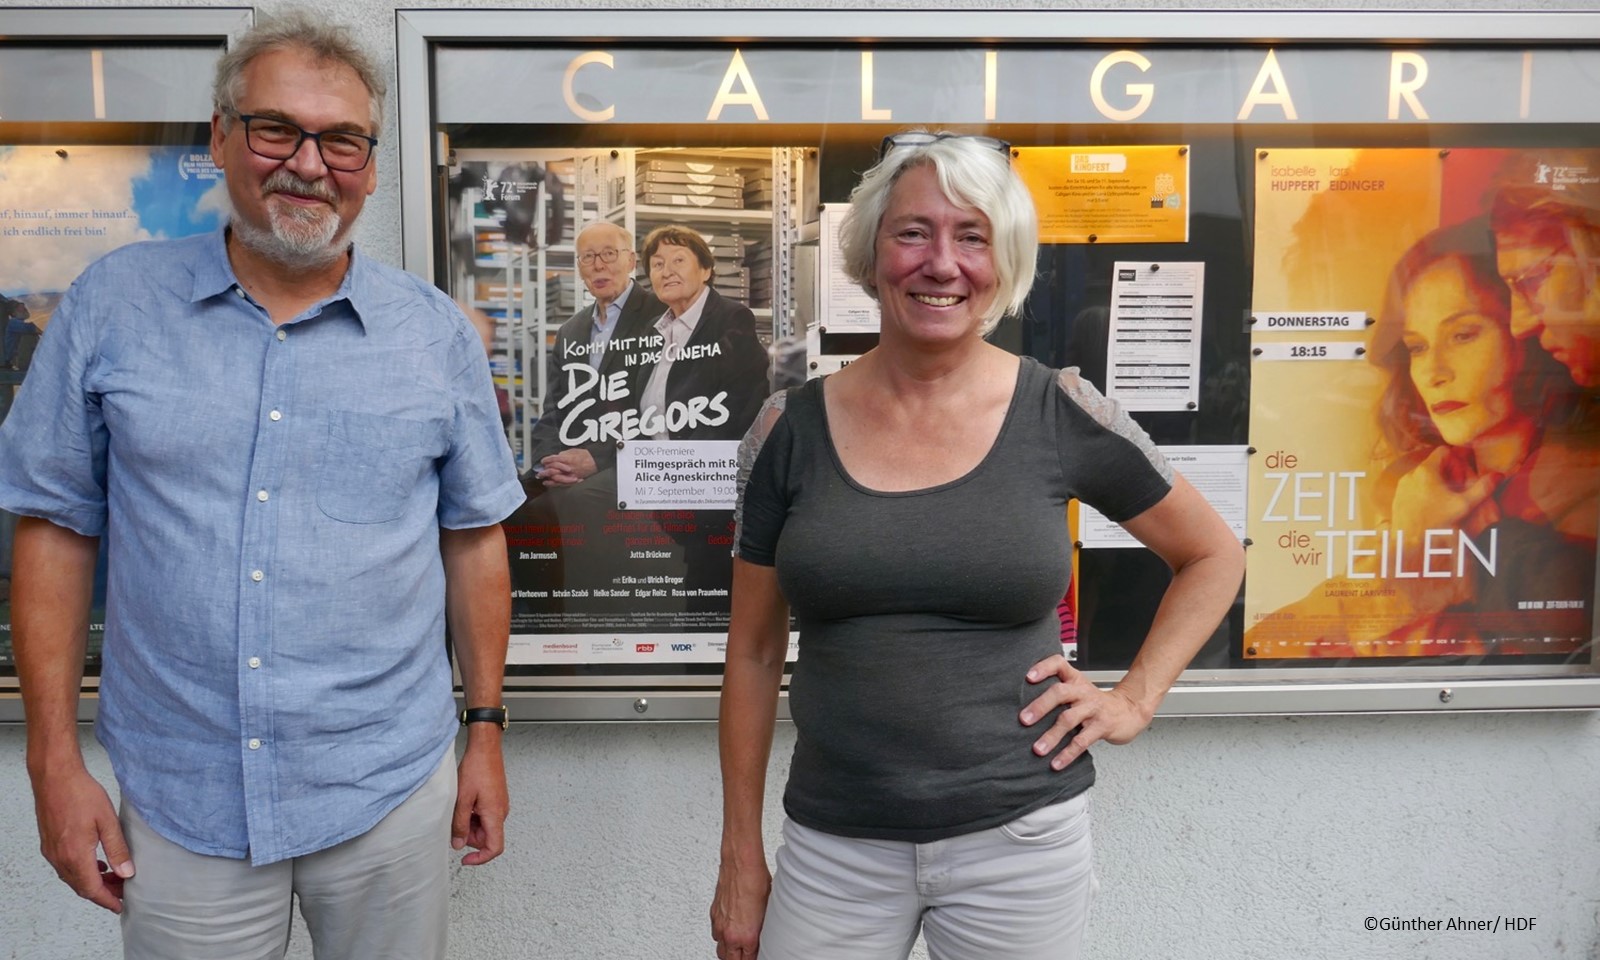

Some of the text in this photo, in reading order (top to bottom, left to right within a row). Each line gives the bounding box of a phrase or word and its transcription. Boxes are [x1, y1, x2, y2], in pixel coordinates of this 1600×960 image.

[1074, 163, 1110, 171] KINOFEST
[1271, 165, 1350, 177] isabelle lars
[1271, 181, 1385, 191] HUPPERT EIDINGER
[55, 210, 88, 219] immer
[4, 227, 107, 236] ich endlich frei bin!
[1268, 316, 1349, 327] DONNERSTAG
[609, 338, 636, 351] MIT
[638, 335, 664, 348] MIR
[1291, 346, 1326, 357] 18:15
[625, 354, 637, 366] IN
[640, 350, 662, 366] DAS
[559, 391, 730, 446] GREGORS
[634, 447, 695, 456] DOK-Premiere
[635, 459, 706, 471] Filmgespräch
[708, 459, 726, 468] mit
[1265, 451, 1298, 469] die
[635, 473, 736, 484] Alice Agneskirchne
[635, 487, 646, 495] Mi
[658, 487, 705, 497] September
[1261, 472, 1366, 528] ZEIT
[1278, 530, 1310, 548] die
[530, 551, 557, 559] Jarmusch
[630, 550, 671, 559] Jutta Brückner
[1292, 548, 1322, 566] wir
[1315, 528, 1497, 579] TEILEN
[622, 576, 636, 584] Erika
[647, 576, 663, 584] Ulrich
[665, 576, 684, 585] Gregor
[518, 590, 548, 598] Verhoeven
[635, 589, 651, 598] Edgar
[652, 589, 667, 597] Reitz
[672, 589, 685, 597] Rosa
[698, 589, 728, 597] Praunheim
